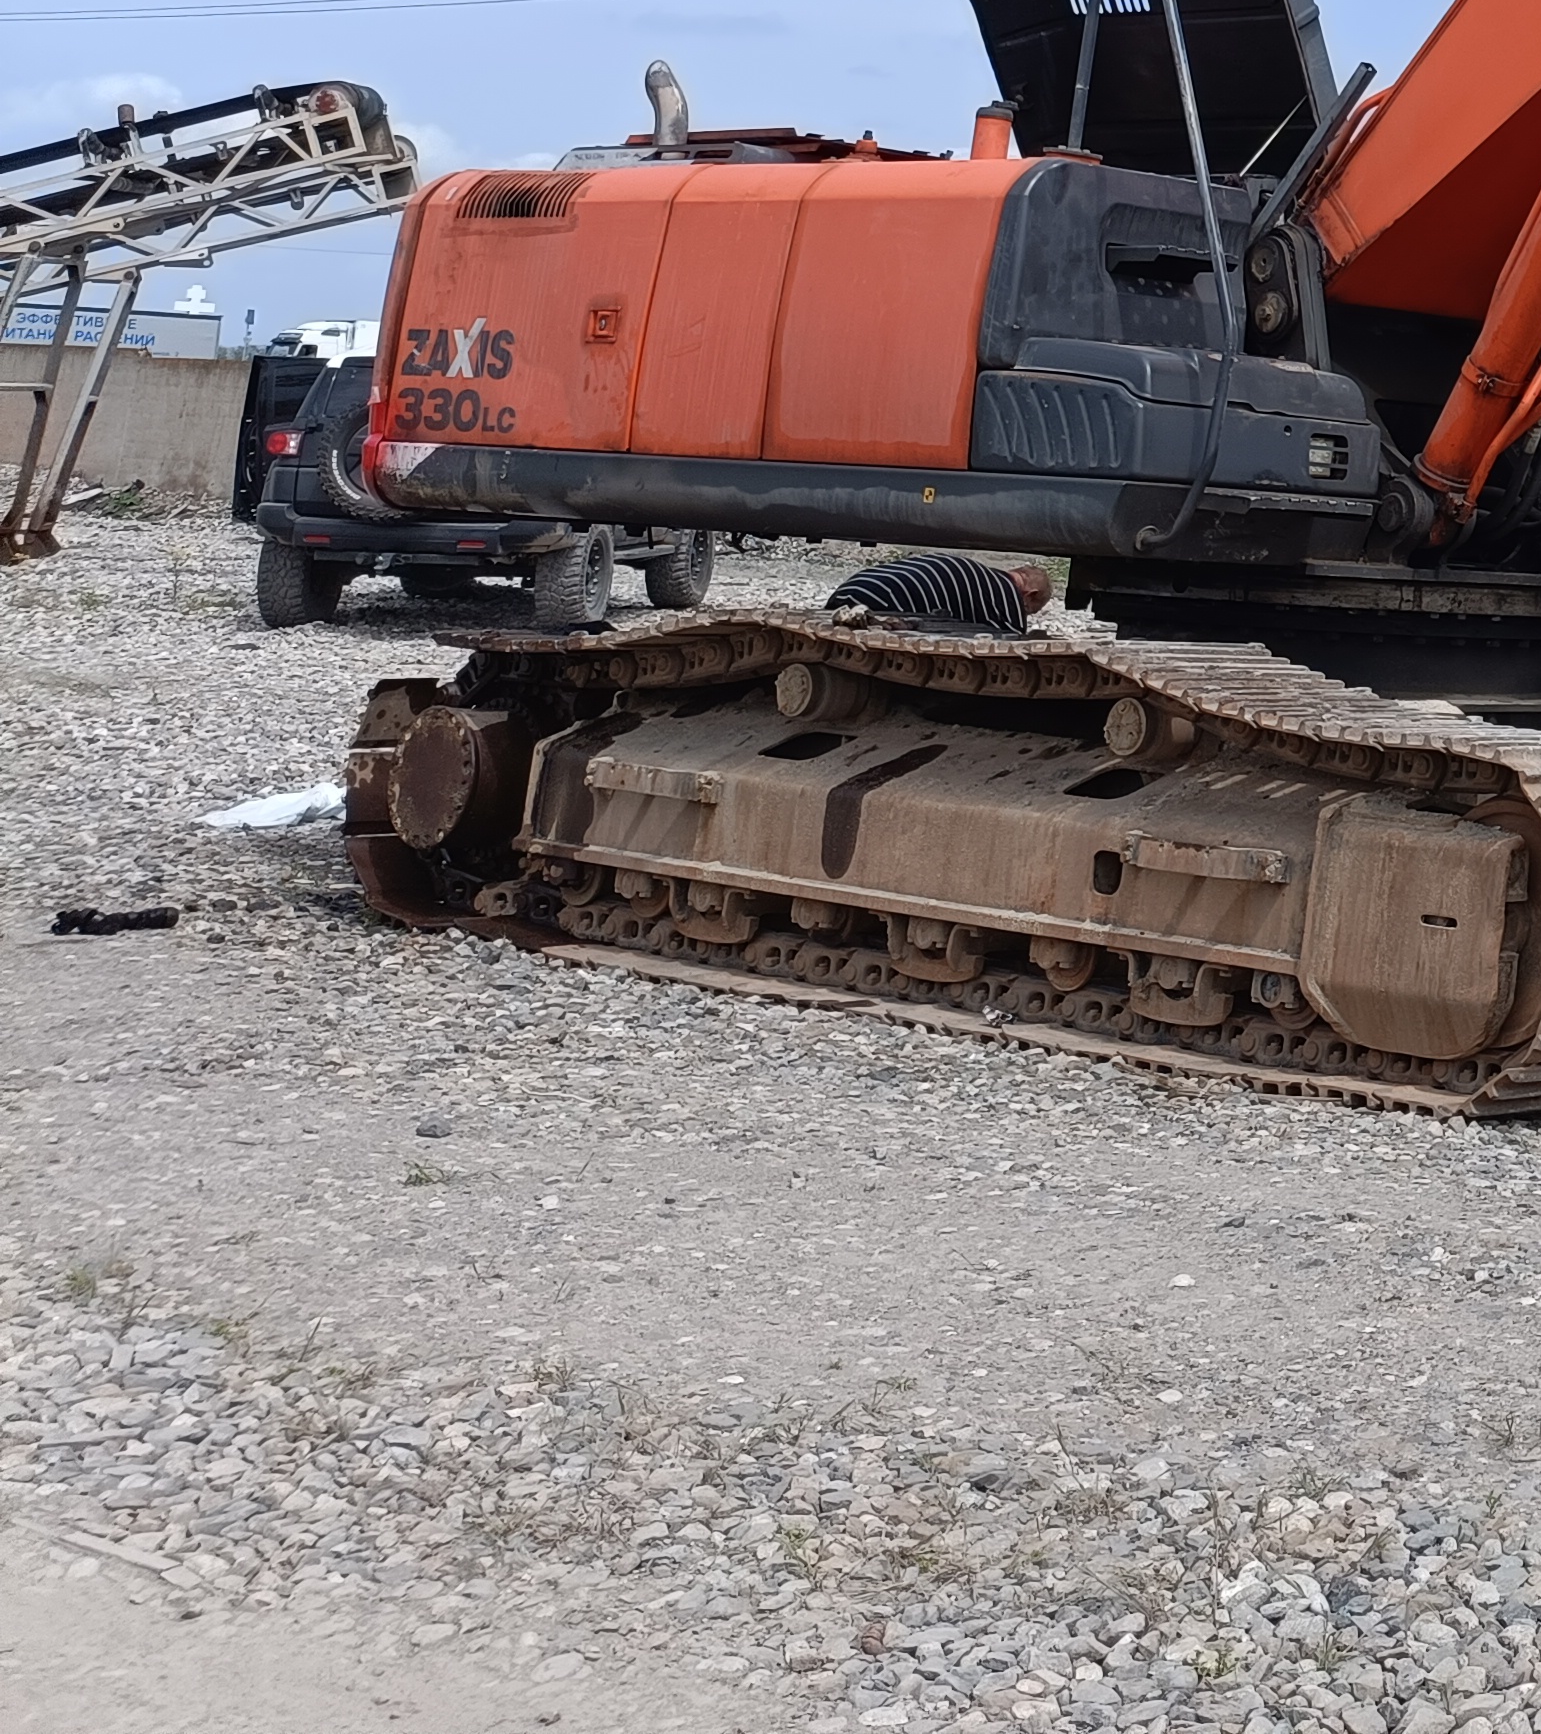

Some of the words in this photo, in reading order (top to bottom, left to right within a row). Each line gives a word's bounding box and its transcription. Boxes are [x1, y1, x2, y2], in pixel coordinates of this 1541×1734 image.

[16, 312, 137, 330] ЭФФЕТИВЕ
[74, 330, 156, 347] РАСНИЙ
[401, 317, 515, 380] ZAXIS
